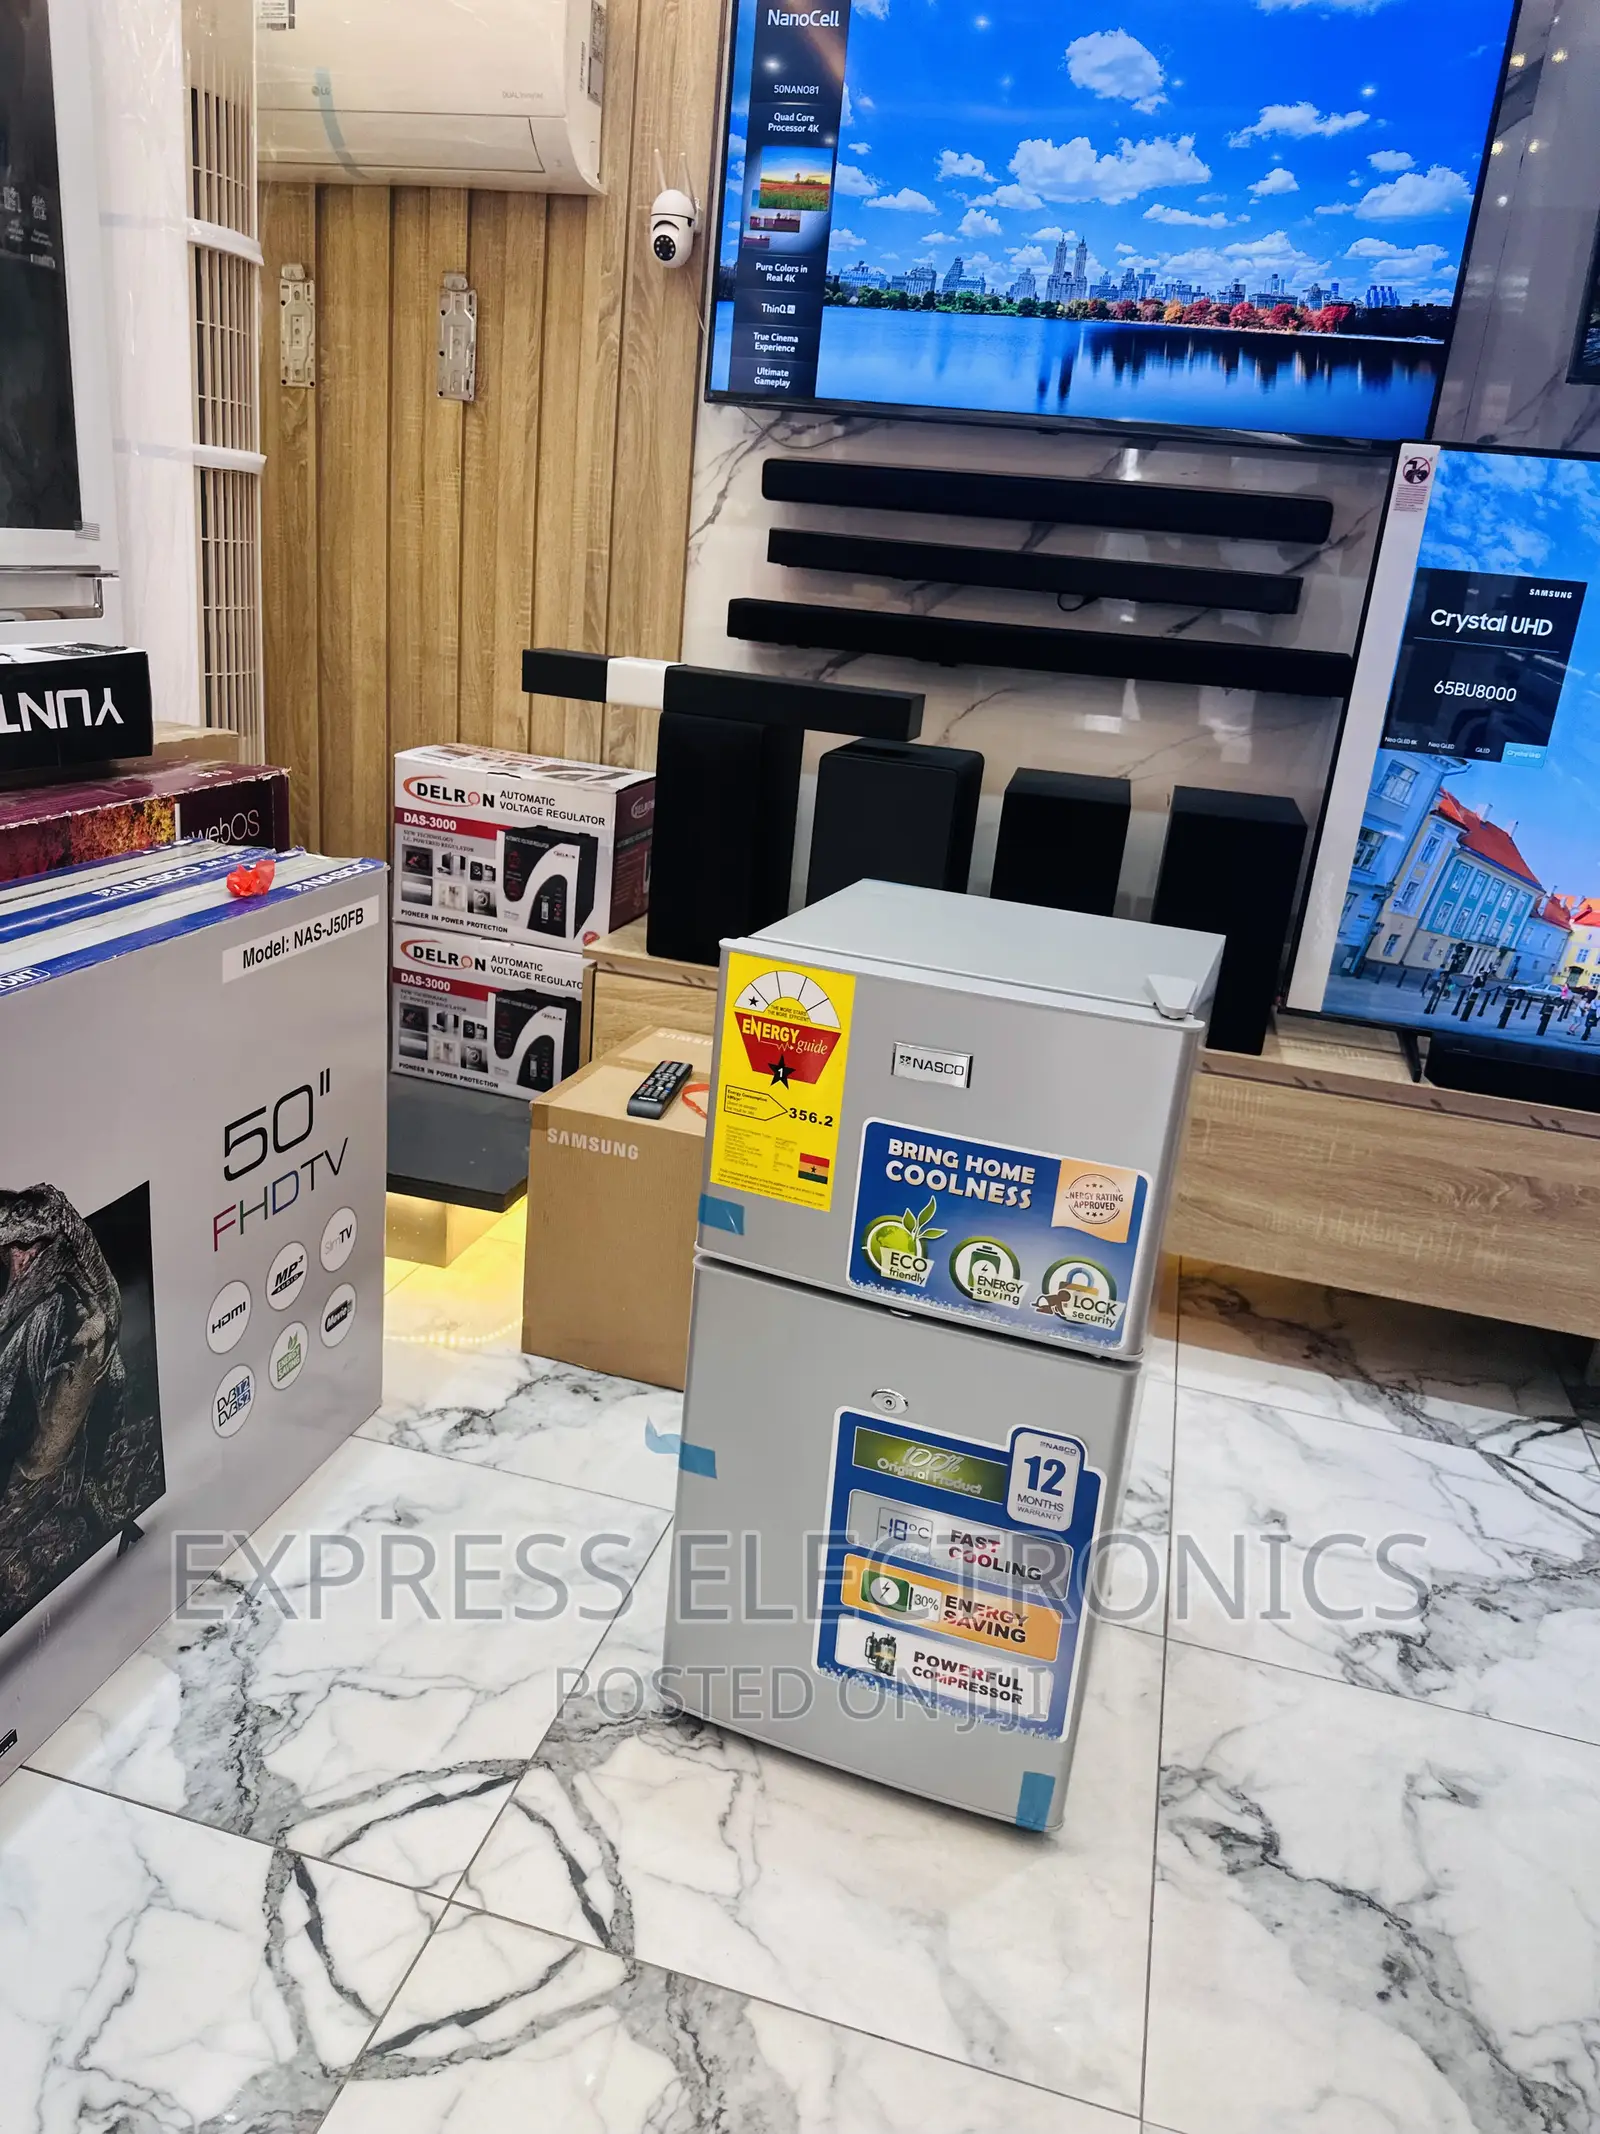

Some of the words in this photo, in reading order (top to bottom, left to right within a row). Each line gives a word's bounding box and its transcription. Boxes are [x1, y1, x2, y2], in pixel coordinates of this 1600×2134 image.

[767, 9, 840, 27] NanoCell
[773, 84, 820, 95] 50NANO81
[773, 112, 795, 122] Quad
[796, 113, 815, 122] Core
[768, 123, 806, 133] Processor
[807, 124, 820, 133] 4K
[755, 262, 773, 272] Pure
[774, 263, 799, 273] Colors
[800, 264, 808, 273] in
[766, 273, 783, 282] Real
[784, 274, 796, 283] 4K
[761, 303, 786, 314] ThinQ
[753, 332, 770, 341] True
[771, 333, 799, 343] Cinema
[754, 342, 796, 353] Experience
[756, 367, 789, 377] Ultimate
[754, 377, 791, 389] Gameplay
[1528, 588, 1573, 600] SAMSUNG
[1430, 608, 1508, 634] Crystal
[1510, 618, 1553, 637] UHD
[1433, 680, 1517, 702] 65BU8000
[416, 782, 495, 808] DELRON
[500, 790, 556, 807] AUTOMATIC
[403, 812, 457, 831] DAS-3000
[500, 802, 543, 816] VOLTAGE
[546, 809, 606, 826] REGULATOR
[191, 809, 260, 844] webOS
[116, 866, 201, 895] NASCO
[302, 863, 375, 891] NASCO
[401, 909, 429, 920] PIONEER
[431, 914, 439, 922] IN
[441, 916, 465, 926] POWER
[466, 920, 508, 933] PROTECTION
[243, 936, 290, 969] Model:
[294, 908, 364, 949] NAS-J50FB
[413, 946, 486, 971] DELRON
[490, 955, 543, 972] AUTOMATIC
[400, 973, 451, 992] DAS-3000
[490, 966, 532, 981] VOLTAGE
[534, 974, 583, 990] REGULATO
[793, 1008, 807, 1017] STARS
[742, 1015, 800, 1044] ENERGY
[795, 1039, 828, 1055] guide
[399, 1062, 425, 1072] PIONEER
[427, 1068, 434, 1076] IN
[436, 1070, 458, 1081] POWER
[460, 1075, 499, 1089] PROTECTION
[778, 1067, 783, 1078] 1
[912, 1057, 965, 1076] NASCO
[788, 1107, 833, 1127] 356.2
[547, 1128, 639, 1160] SAMSUNG
[888, 1138, 959, 1170] BRING
[964, 1154, 1036, 1185] HOME
[213, 1137, 348, 1252] FHDTV
[885, 1160, 1033, 1210] COOLNESS
[1073, 1201, 1116, 1211] APPROVED
[1095, 1193, 1124, 1202] RATING
[890, 1251, 928, 1272] ECO
[277, 1274, 300, 1292] AUDIO
[889, 1265, 926, 1284] friendly
[977, 1274, 1023, 1294] ENERGY
[976, 1286, 1020, 1305] saving
[1072, 1294, 1118, 1316] LOCK
[211, 1301, 246, 1334] HDMI
[1072, 1308, 1116, 1328] security
[278, 1345, 300, 1370] ENERGY
[278, 1356, 300, 1381] SAVING
[1045, 1442, 1077, 1455] NASCO
[902, 1446, 964, 1473] 100%
[877, 1457, 930, 1481] Original
[932, 1471, 983, 1495] Product
[1024, 1455, 1066, 1497] 12
[1017, 1493, 1064, 1512] MONTHS
[1017, 1506, 1062, 1522] WARRANTY
[950, 1529, 1001, 1554] FAST
[948, 1546, 1043, 1581] COOLING
[914, 1593, 939, 1611] 30%
[945, 1595, 1029, 1627] ENERGY
[943, 1609, 1026, 1643] SAVING
[913, 1651, 1024, 1692] POWERFUL
[912, 1666, 1023, 1705] COMPRESSOR
